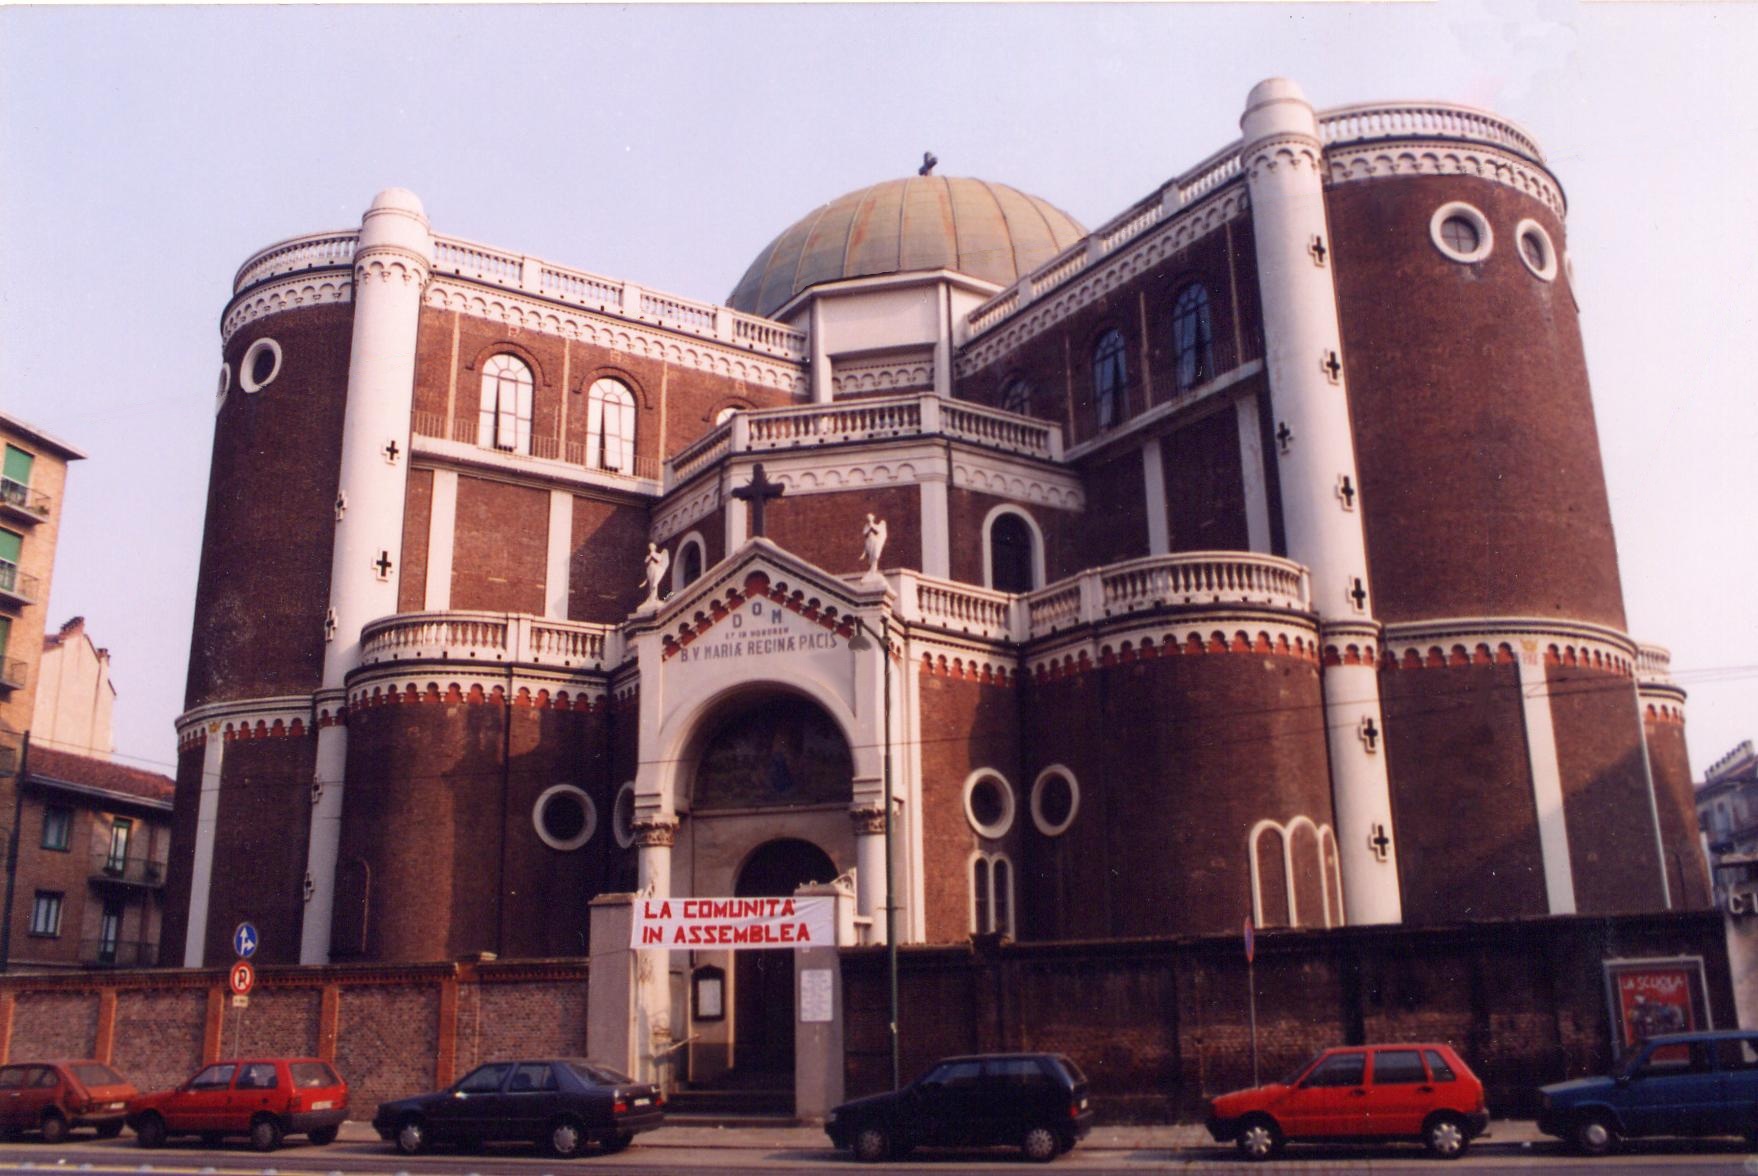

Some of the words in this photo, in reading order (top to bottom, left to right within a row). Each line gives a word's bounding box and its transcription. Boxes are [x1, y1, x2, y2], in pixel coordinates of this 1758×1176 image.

[799, 632, 838, 649] PACIS
[644, 901, 671, 919] LA
[642, 926, 663, 944] IN
[674, 923, 810, 944] ASSEMBLEA
